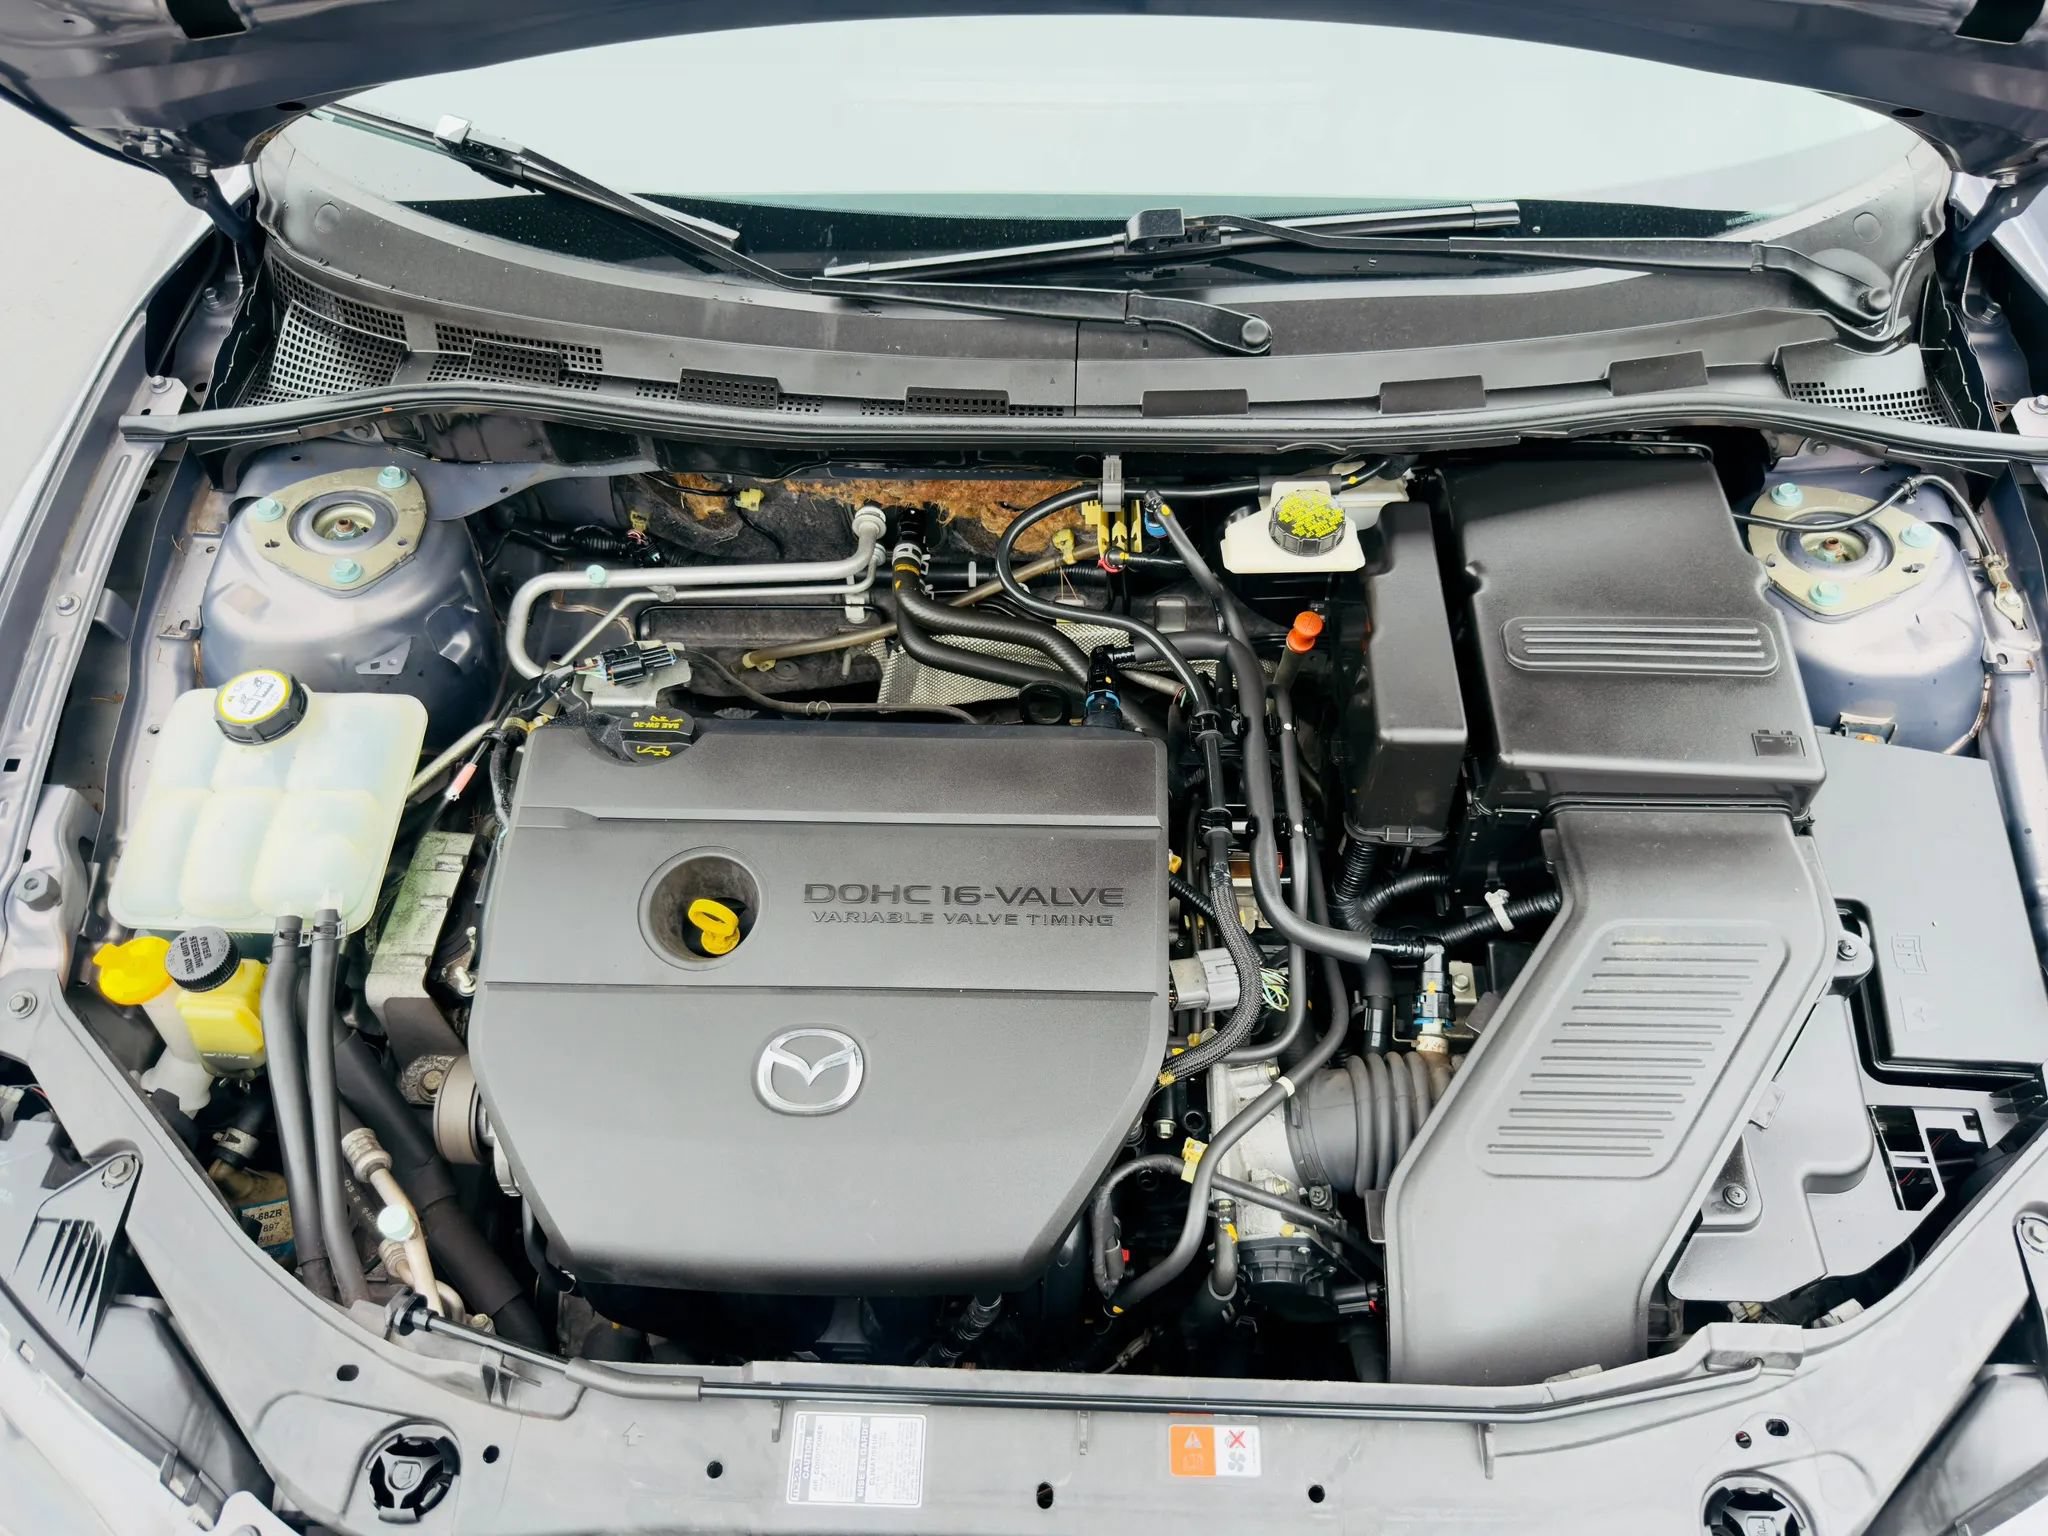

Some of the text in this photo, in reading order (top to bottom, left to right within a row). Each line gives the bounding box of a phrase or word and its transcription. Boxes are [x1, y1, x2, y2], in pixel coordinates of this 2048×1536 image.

[633, 721, 680, 729] SAE 5W-20
[803, 884, 1124, 907] DOHC 16-VALVE
[811, 910, 1115, 927] VARIABLE VALVE TIMING
[802, 1436, 813, 1480] CAUTION
